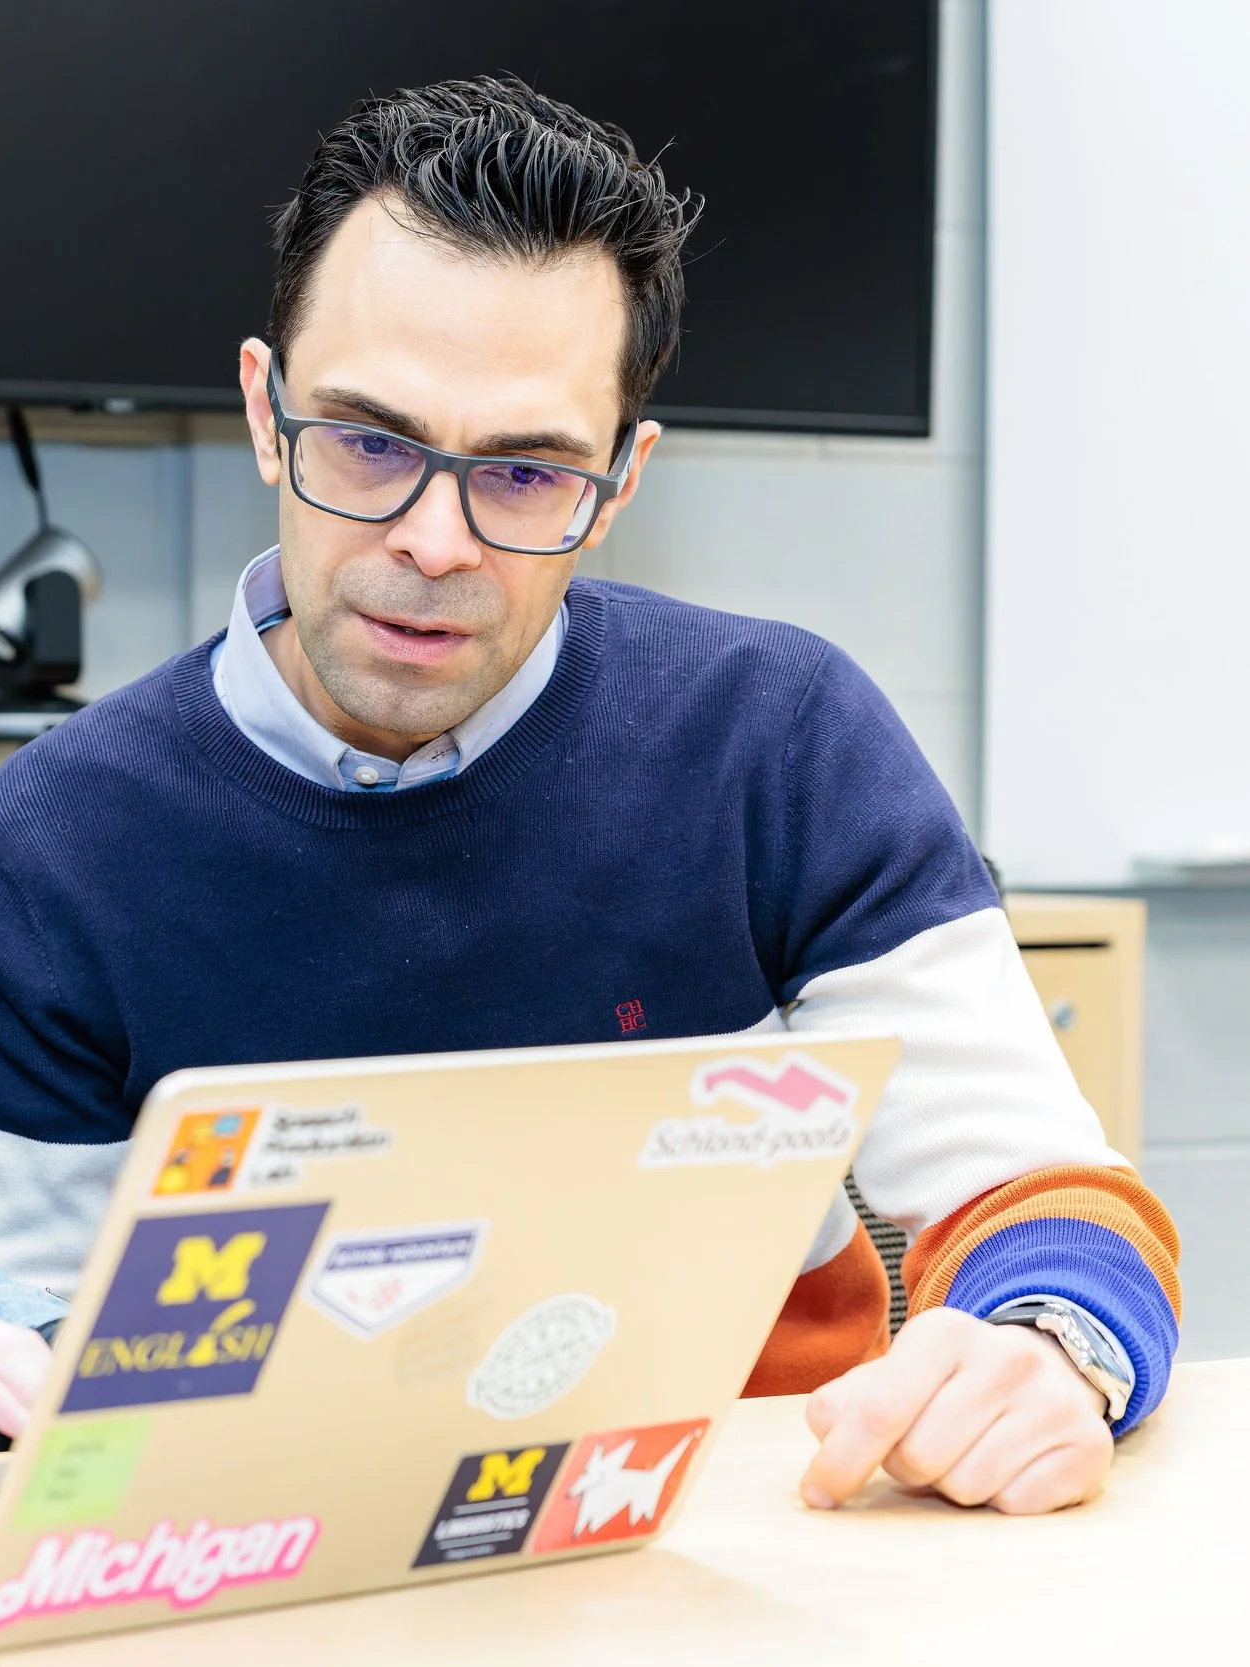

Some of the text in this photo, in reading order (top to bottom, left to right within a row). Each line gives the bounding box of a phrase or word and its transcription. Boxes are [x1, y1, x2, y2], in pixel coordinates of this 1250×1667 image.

[615, 999, 644, 1018] CH
[618, 1014, 646, 1033] HC
[156, 1231, 268, 1306] M
[77, 1322, 274, 1378] ENGLISH
[465, 1447, 547, 1502] M
